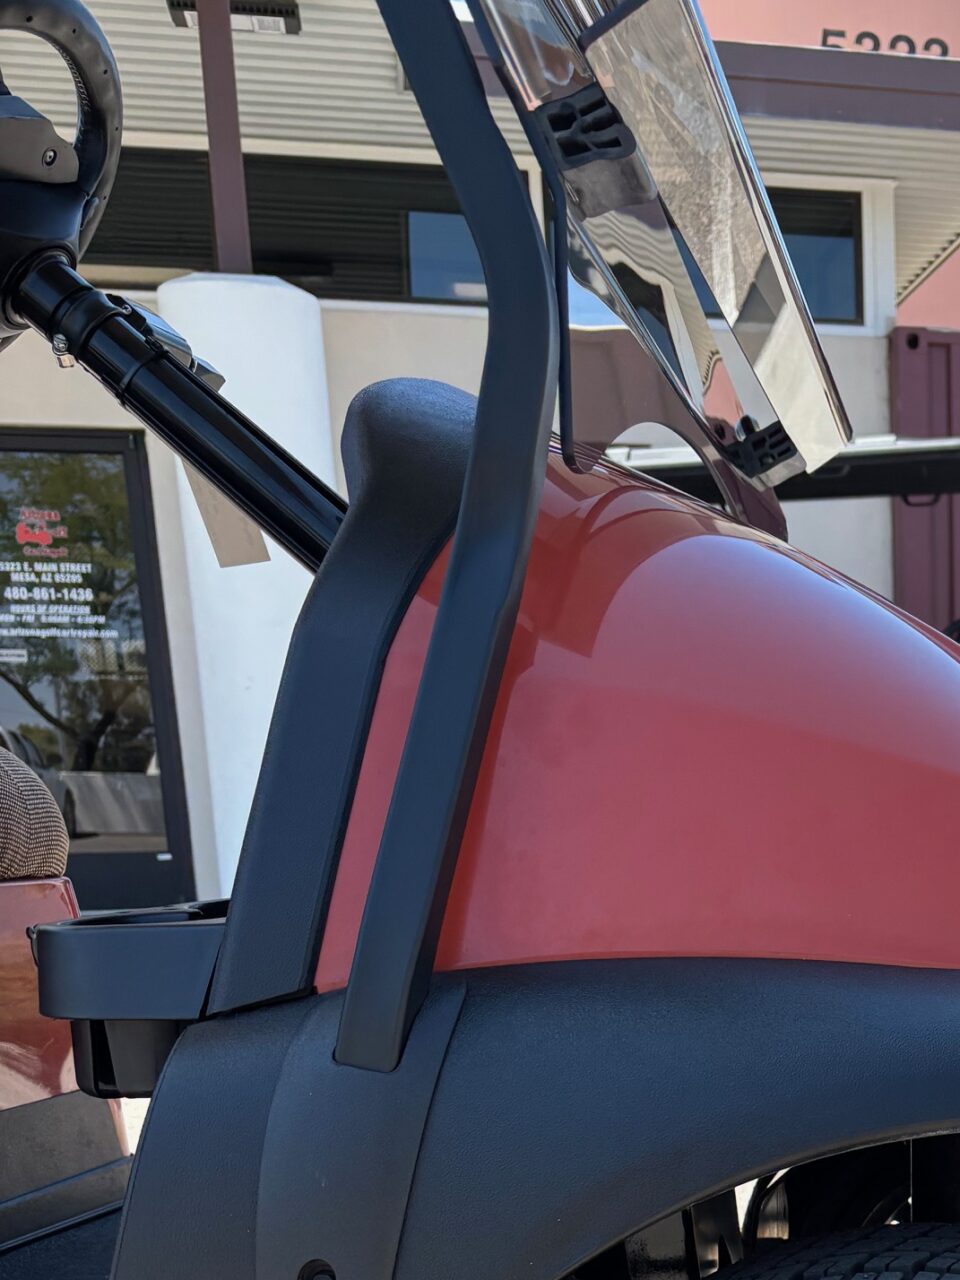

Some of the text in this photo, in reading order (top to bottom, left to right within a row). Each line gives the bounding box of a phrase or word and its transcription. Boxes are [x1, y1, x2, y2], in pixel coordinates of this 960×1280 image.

[33, 562, 58, 572] MAIN
[59, 563, 92, 573] STREET
[10, 572, 39, 583] MESA,
[40, 573, 53, 582] AZ
[4, 586, 94, 602] 480-861-1436
